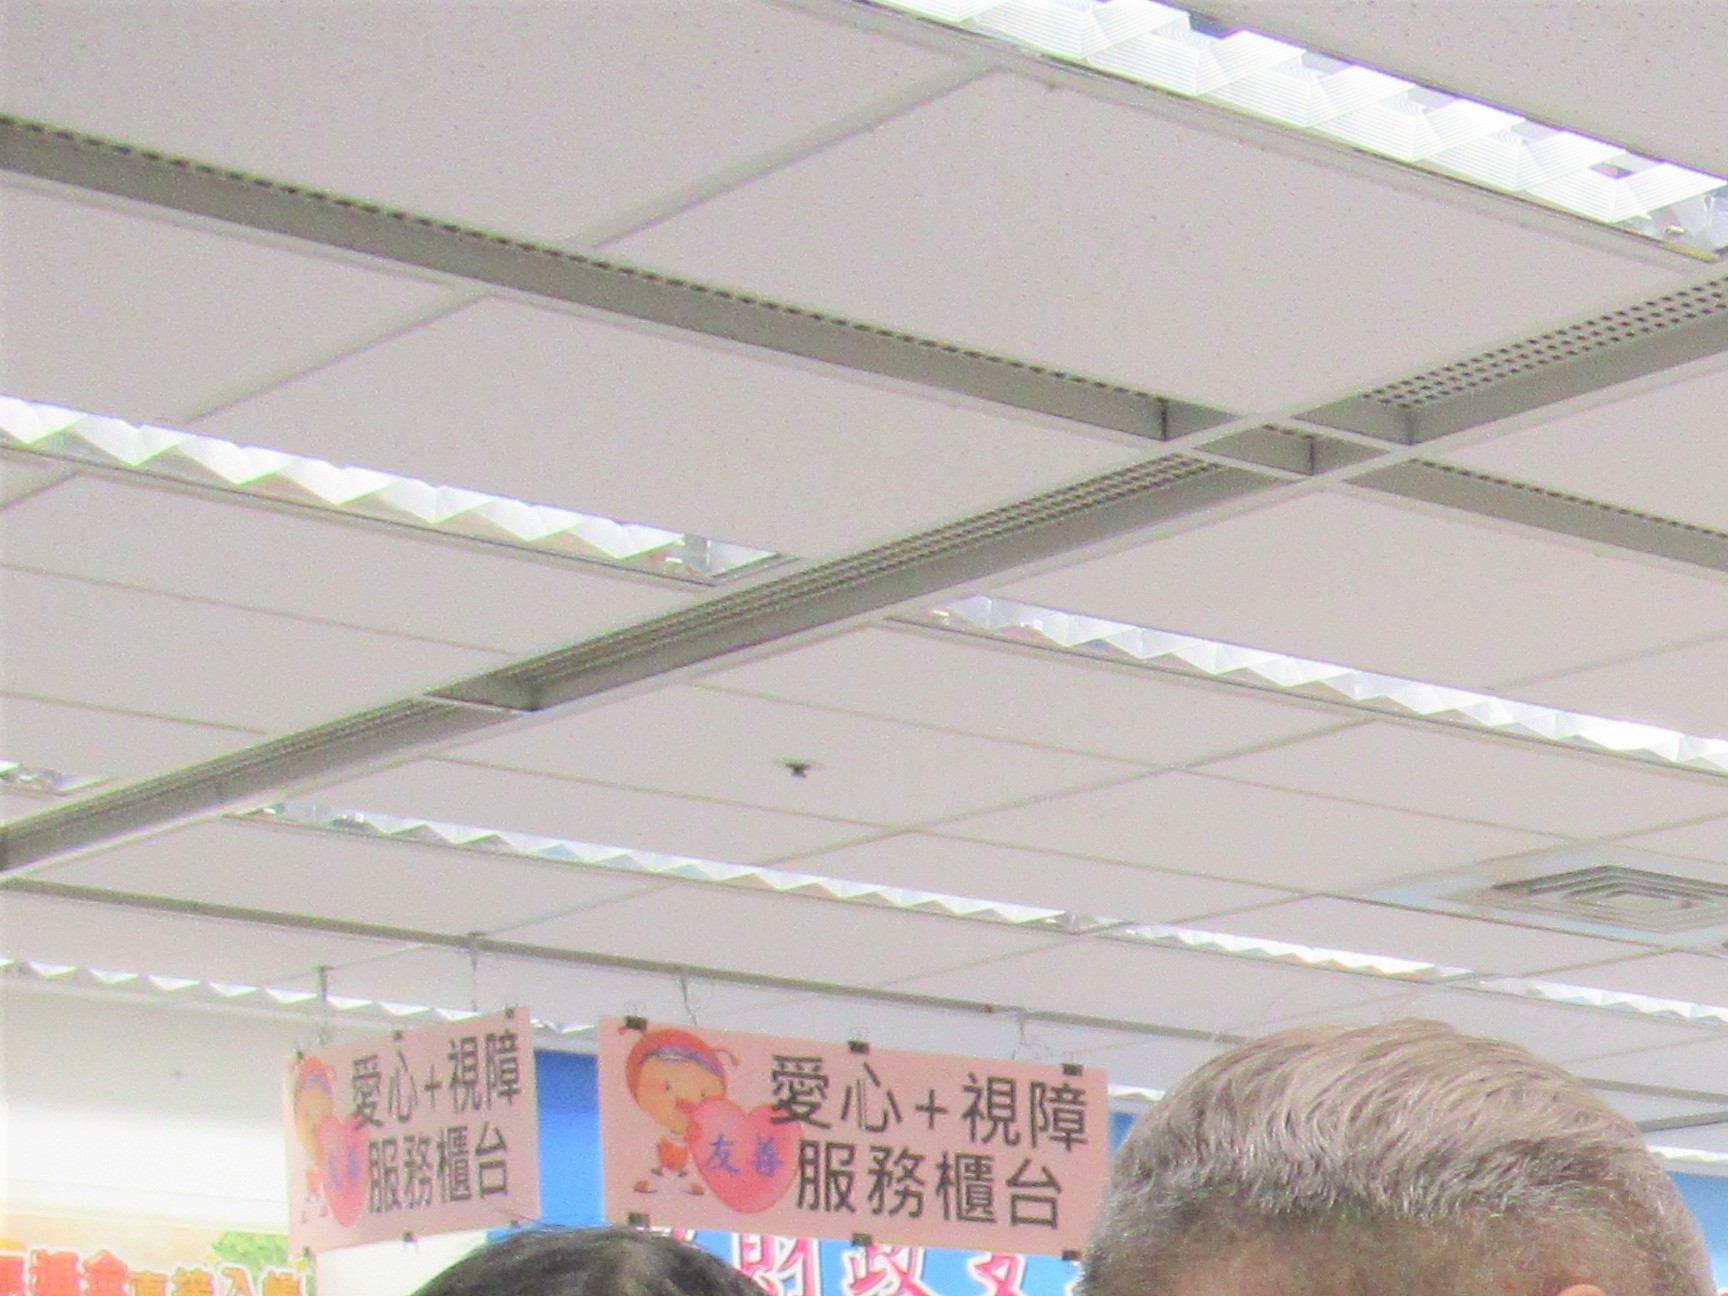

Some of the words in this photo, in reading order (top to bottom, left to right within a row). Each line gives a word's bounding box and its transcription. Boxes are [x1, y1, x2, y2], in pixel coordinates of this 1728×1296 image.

[352, 1029, 521, 1129] 愛心+視障
[770, 1054, 1089, 1152] 愛心+視障
[368, 1119, 509, 1214] 服務櫃台
[796, 1138, 1063, 1231] 服務櫃台
